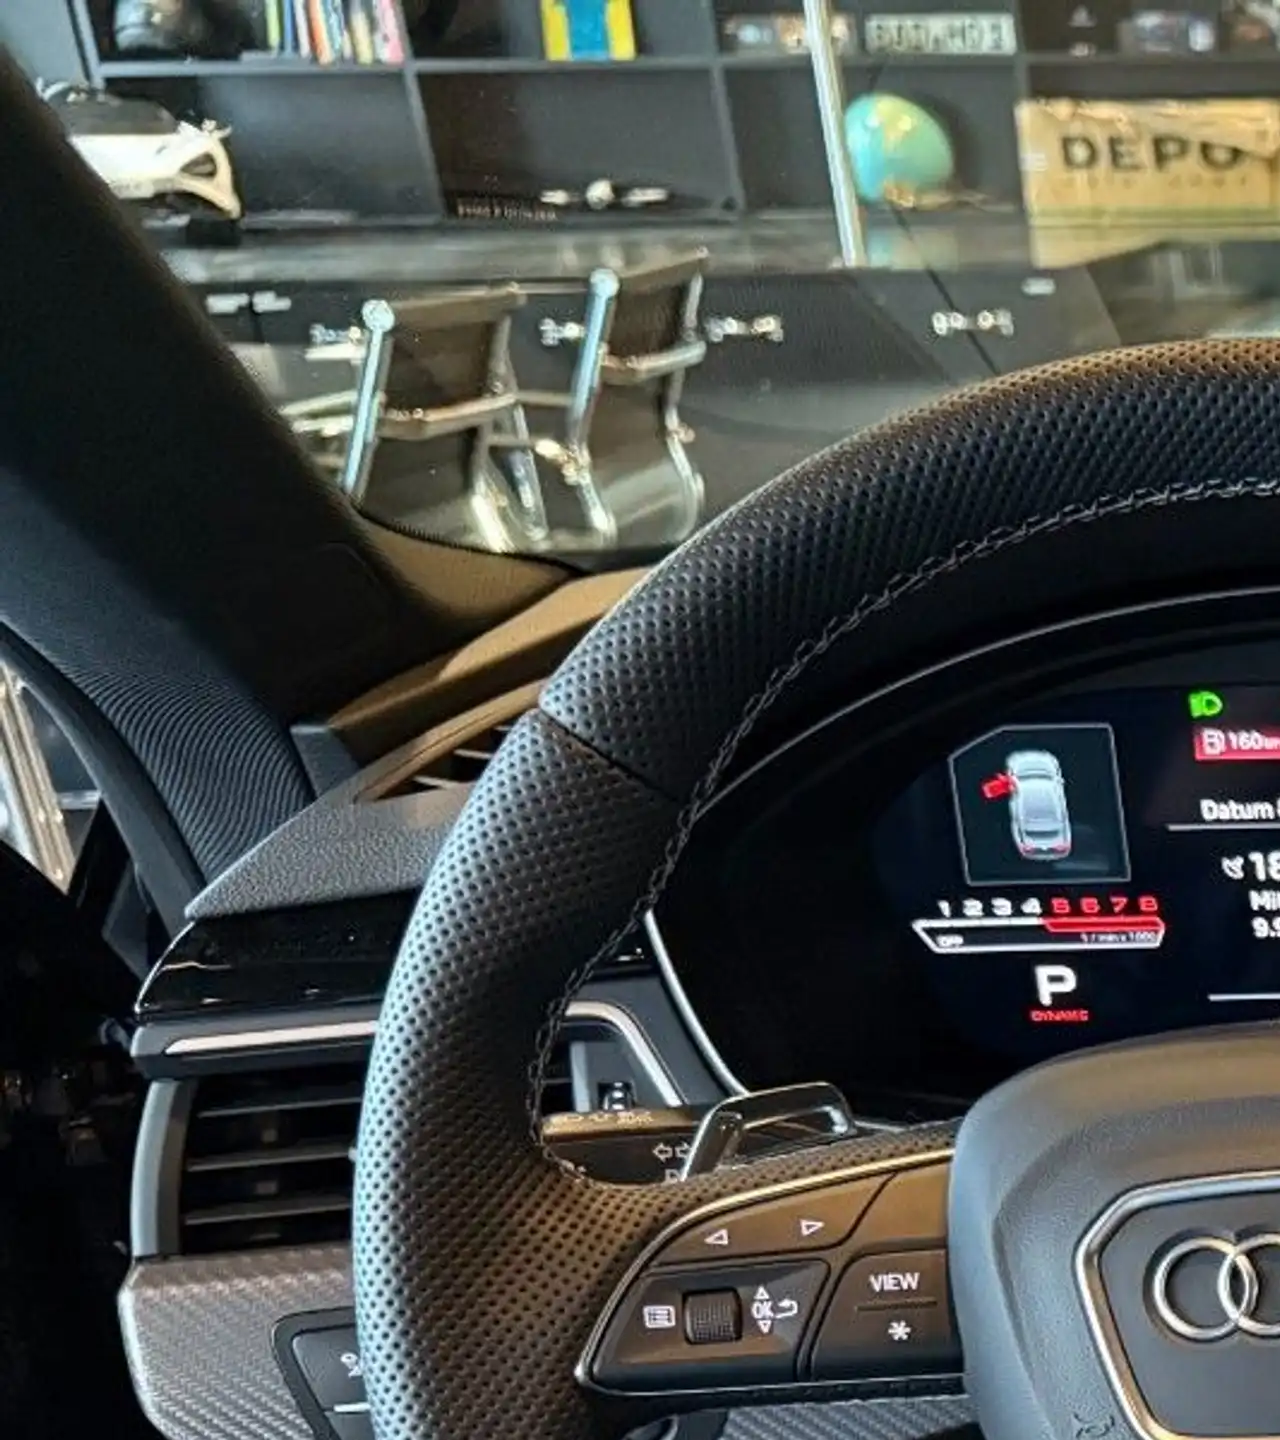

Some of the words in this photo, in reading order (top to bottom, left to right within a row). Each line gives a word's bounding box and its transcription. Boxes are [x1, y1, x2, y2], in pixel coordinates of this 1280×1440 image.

[1230, 731, 1261, 750] 160
[1201, 800, 1274, 820] Datum
[938, 899, 951, 917] 1
[963, 899, 983, 917] 2
[991, 899, 1012, 917] 3
[1021, 898, 1042, 916] 4
[1112, 898, 1128, 914] 7
[1034, 965, 1076, 1006] P
[869, 1272, 920, 1292] VIEW
[752, 1301, 774, 1319] OK
